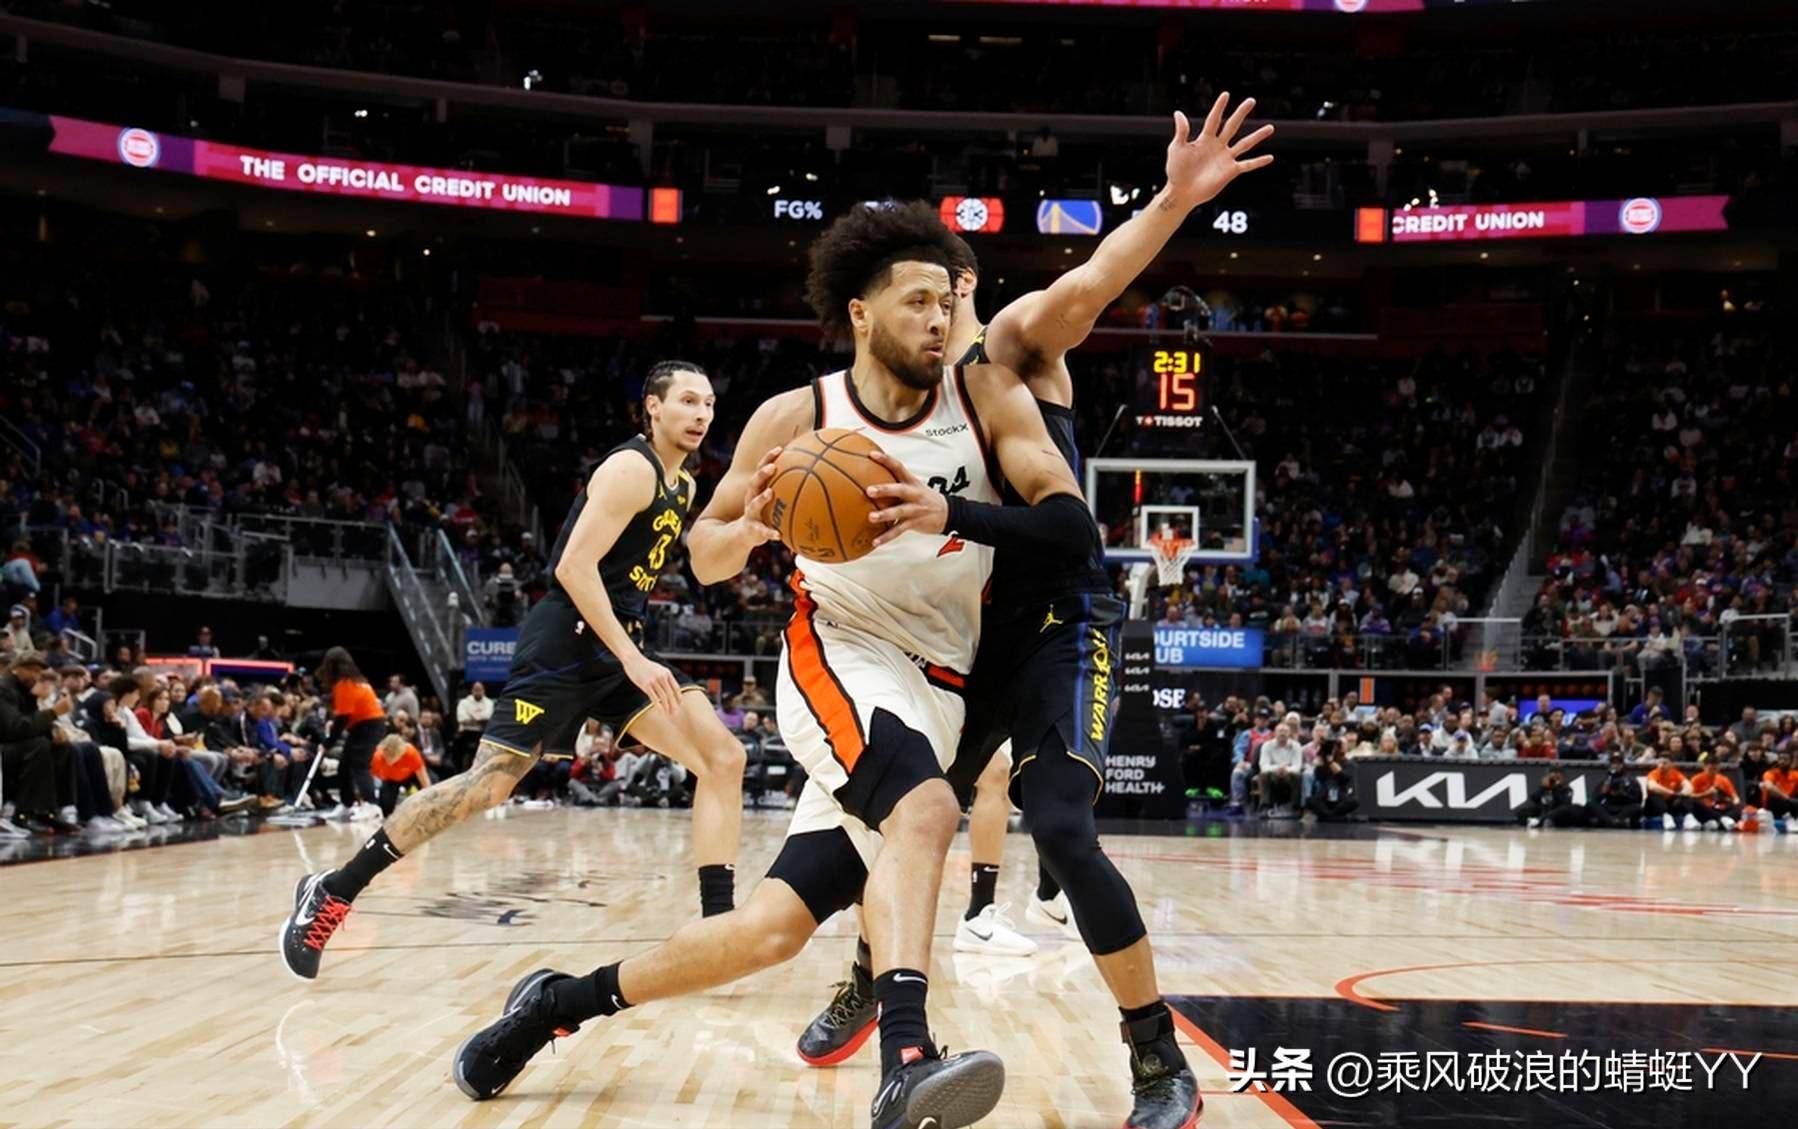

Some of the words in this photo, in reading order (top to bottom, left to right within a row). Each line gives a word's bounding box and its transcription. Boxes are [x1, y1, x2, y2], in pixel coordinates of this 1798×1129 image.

[240, 154, 285, 181] THE
[297, 163, 403, 192] OFFICIAL
[414, 175, 496, 199] CREDIT
[502, 184, 571, 207] UNION
[774, 199, 823, 220] FG%
[1212, 210, 1249, 234] 48
[1475, 211, 1545, 231] UNION
[1153, 351, 1201, 374] 2:31
[1160, 372, 1195, 410] 15
[467, 641, 517, 655] CURE
[1105, 755, 1156, 768] HENRY
[1105, 769, 1145, 780] FORD
[1376, 770, 1528, 811] KIA
